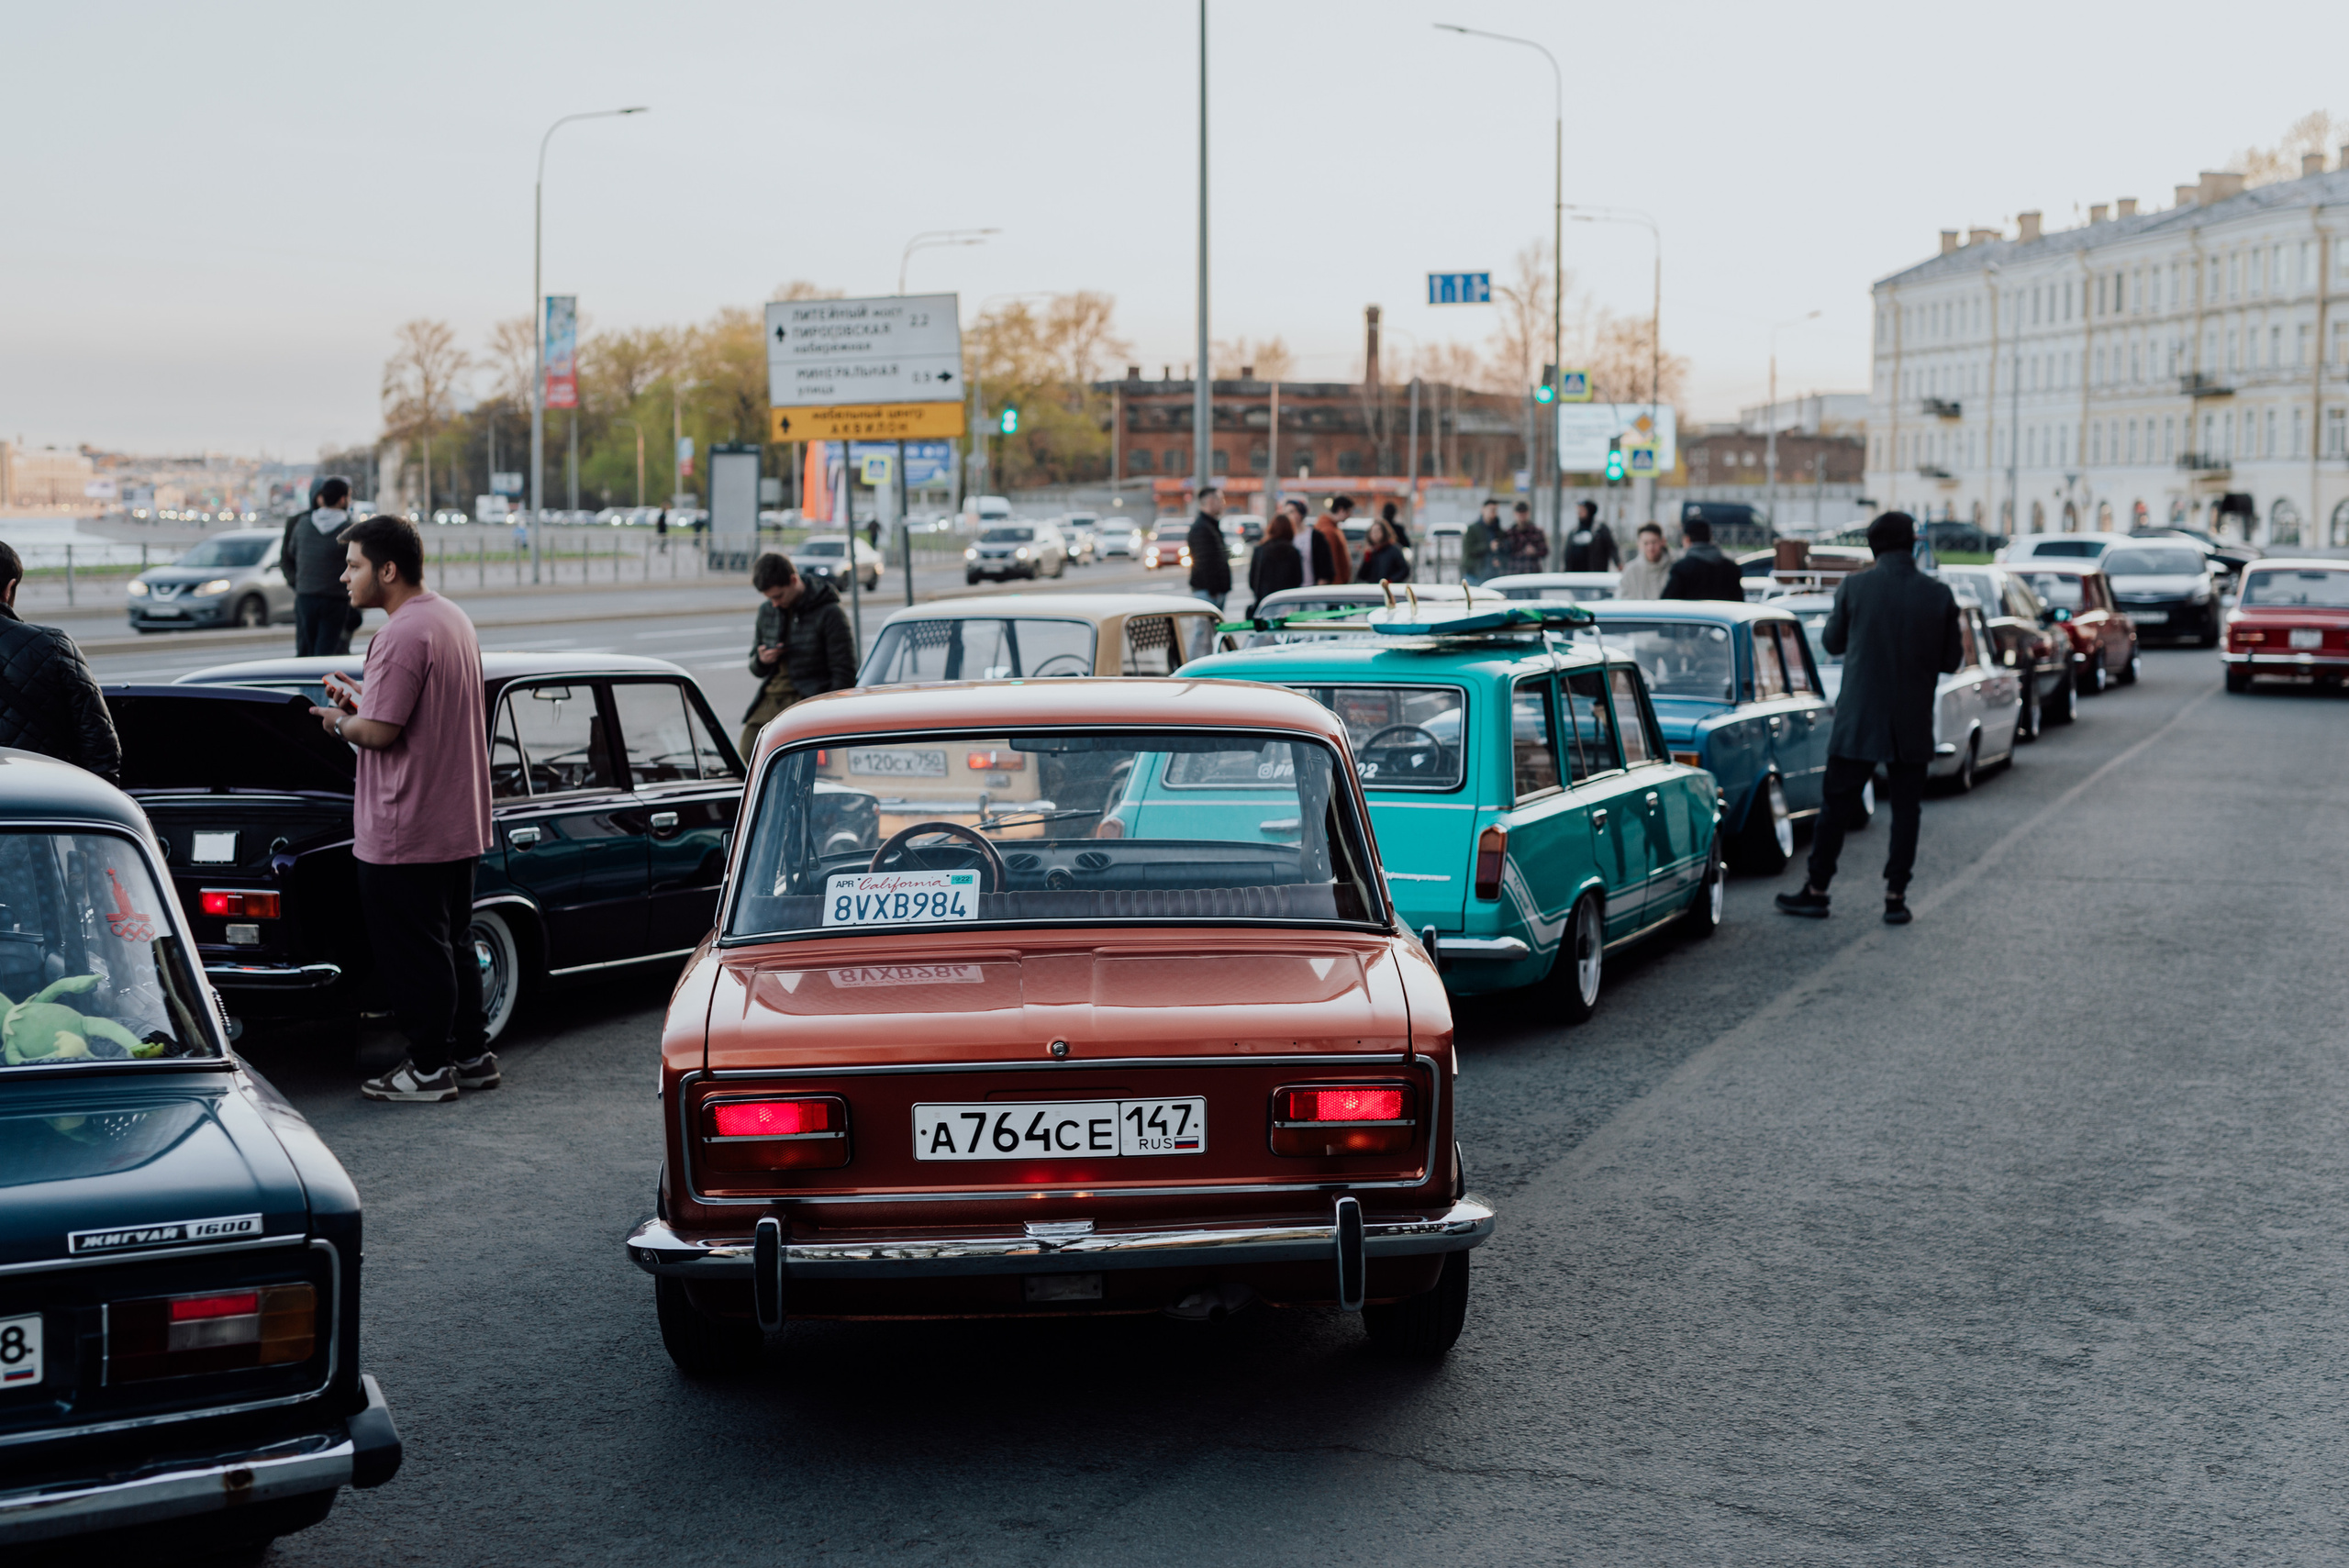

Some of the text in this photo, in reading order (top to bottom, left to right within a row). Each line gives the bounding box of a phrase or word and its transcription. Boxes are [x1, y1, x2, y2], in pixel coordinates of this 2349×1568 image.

[793, 305, 868, 321] ЛИТЕЙНЫЙ
[796, 363, 898, 379] МИНЕРАЛЬНАЯ
[836, 876, 952, 893] APR California
[834, 891, 966, 921] 8VXB984
[1125, 1104, 1192, 1138] 147
[1139, 1138, 1173, 1151] RUS
[195, 1220, 252, 1236] 1600
